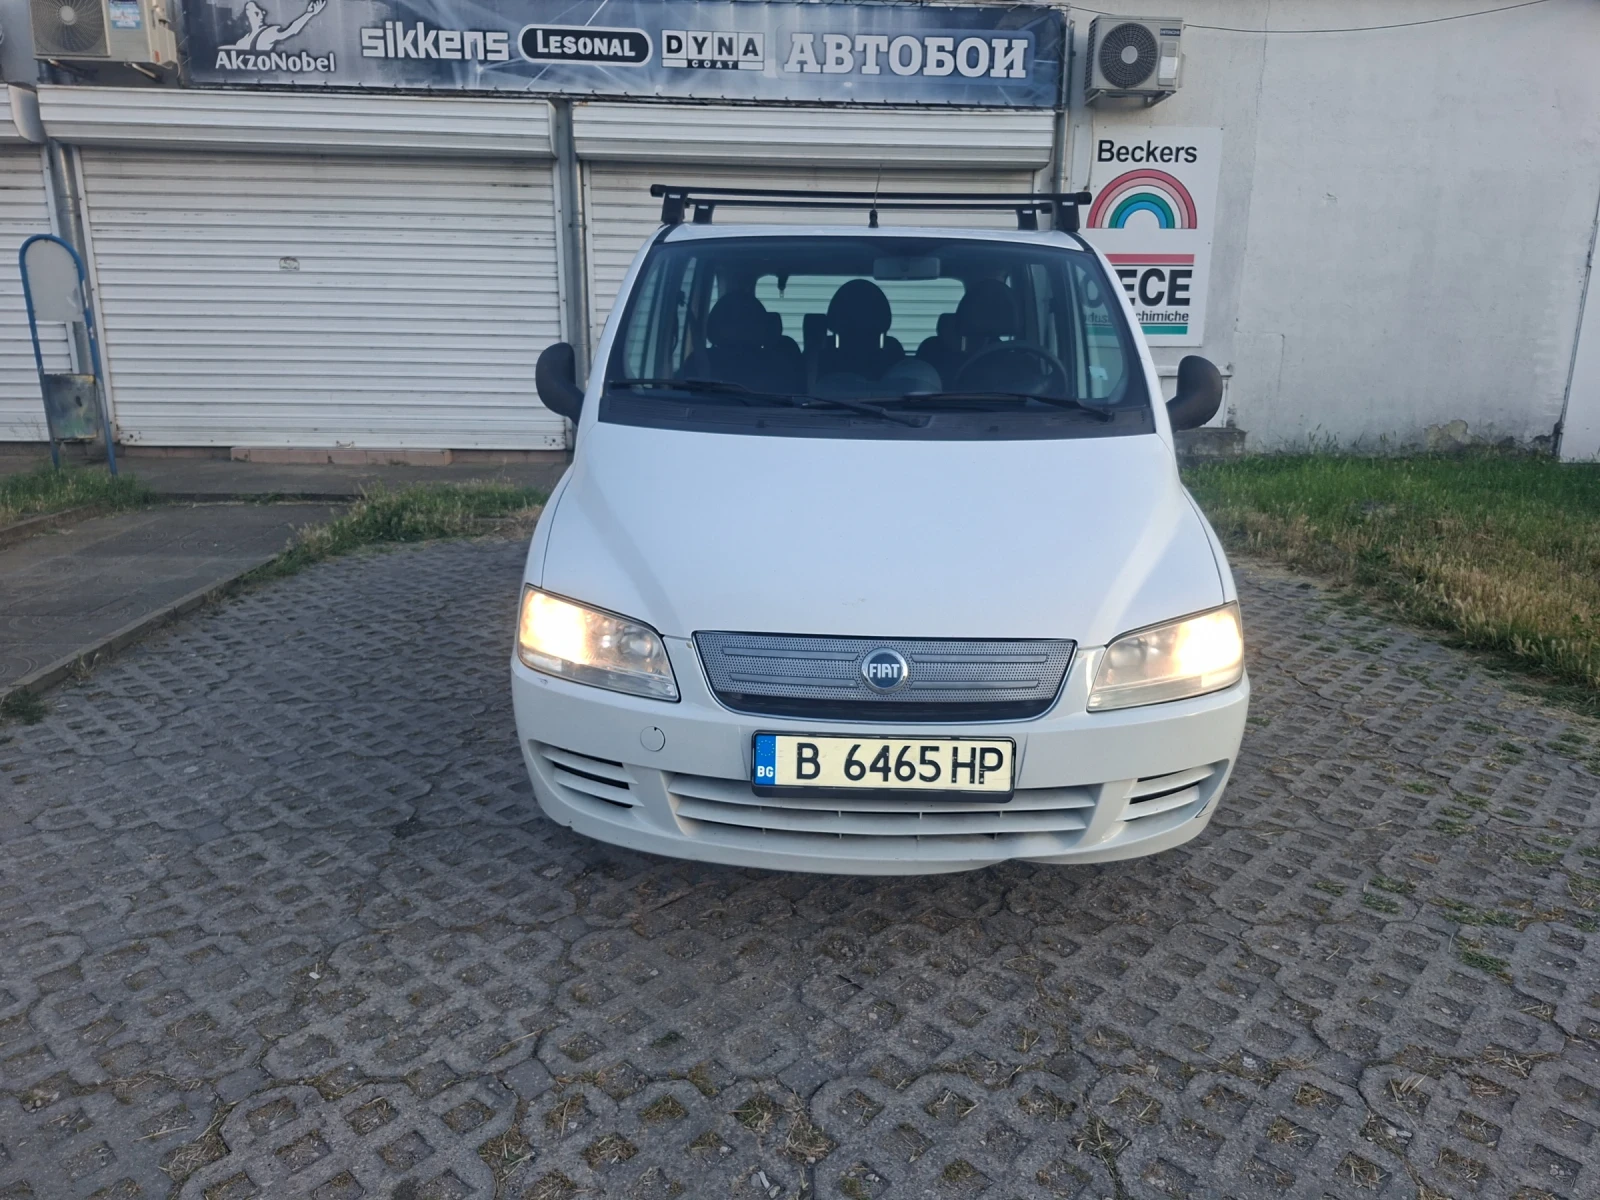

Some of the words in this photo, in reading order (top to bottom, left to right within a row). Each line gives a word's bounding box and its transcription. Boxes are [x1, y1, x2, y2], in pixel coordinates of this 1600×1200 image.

[361, 21, 509, 60] sikkens
[536, 30, 636, 56] LESONAL
[665, 34, 760, 57] DYNA
[215, 50, 336, 72] AkzoNobel
[691, 60, 734, 69] COAT
[783, 33, 1029, 78] АВТОБОИ
[1097, 139, 1198, 164] Beckers
[869, 663, 901, 679] FIAT
[757, 765, 774, 778] BG
[796, 742, 821, 780] B
